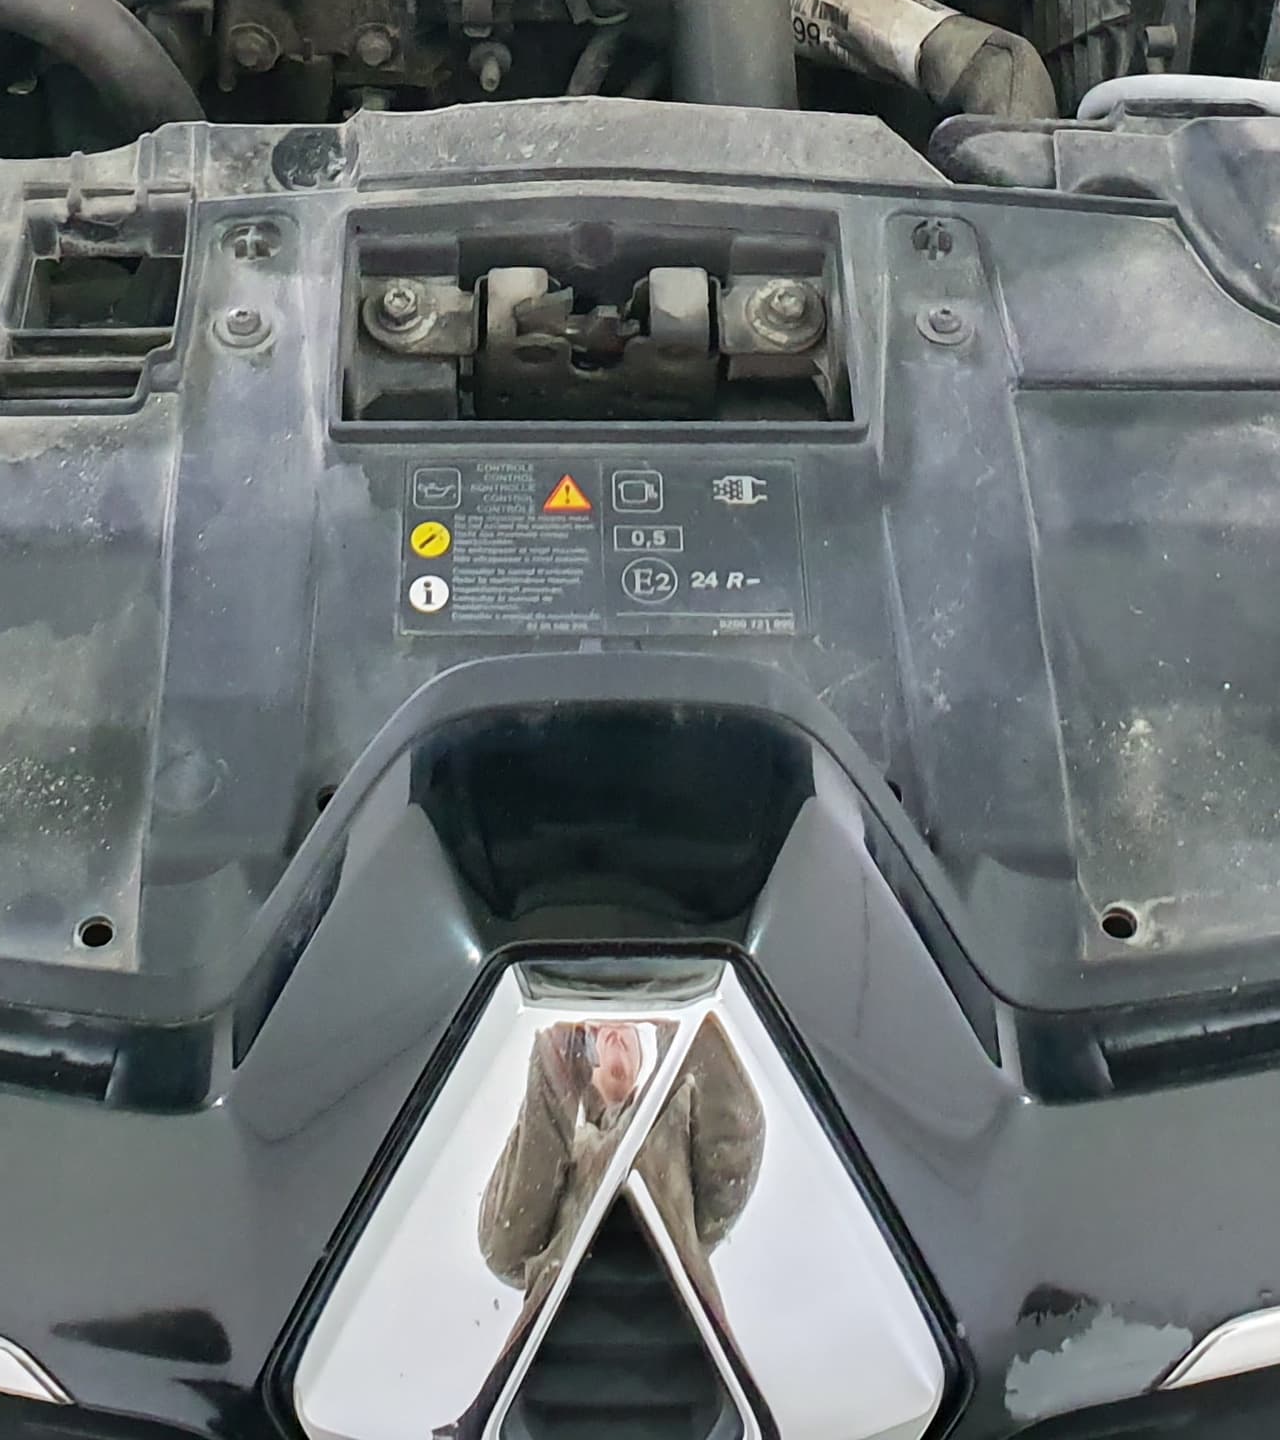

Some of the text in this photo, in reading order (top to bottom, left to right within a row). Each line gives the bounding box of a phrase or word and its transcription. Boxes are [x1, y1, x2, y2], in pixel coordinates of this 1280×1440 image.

[631, 530, 666, 547] 0,5
[633, 567, 671, 595] E2
[691, 571, 719, 589] 24
